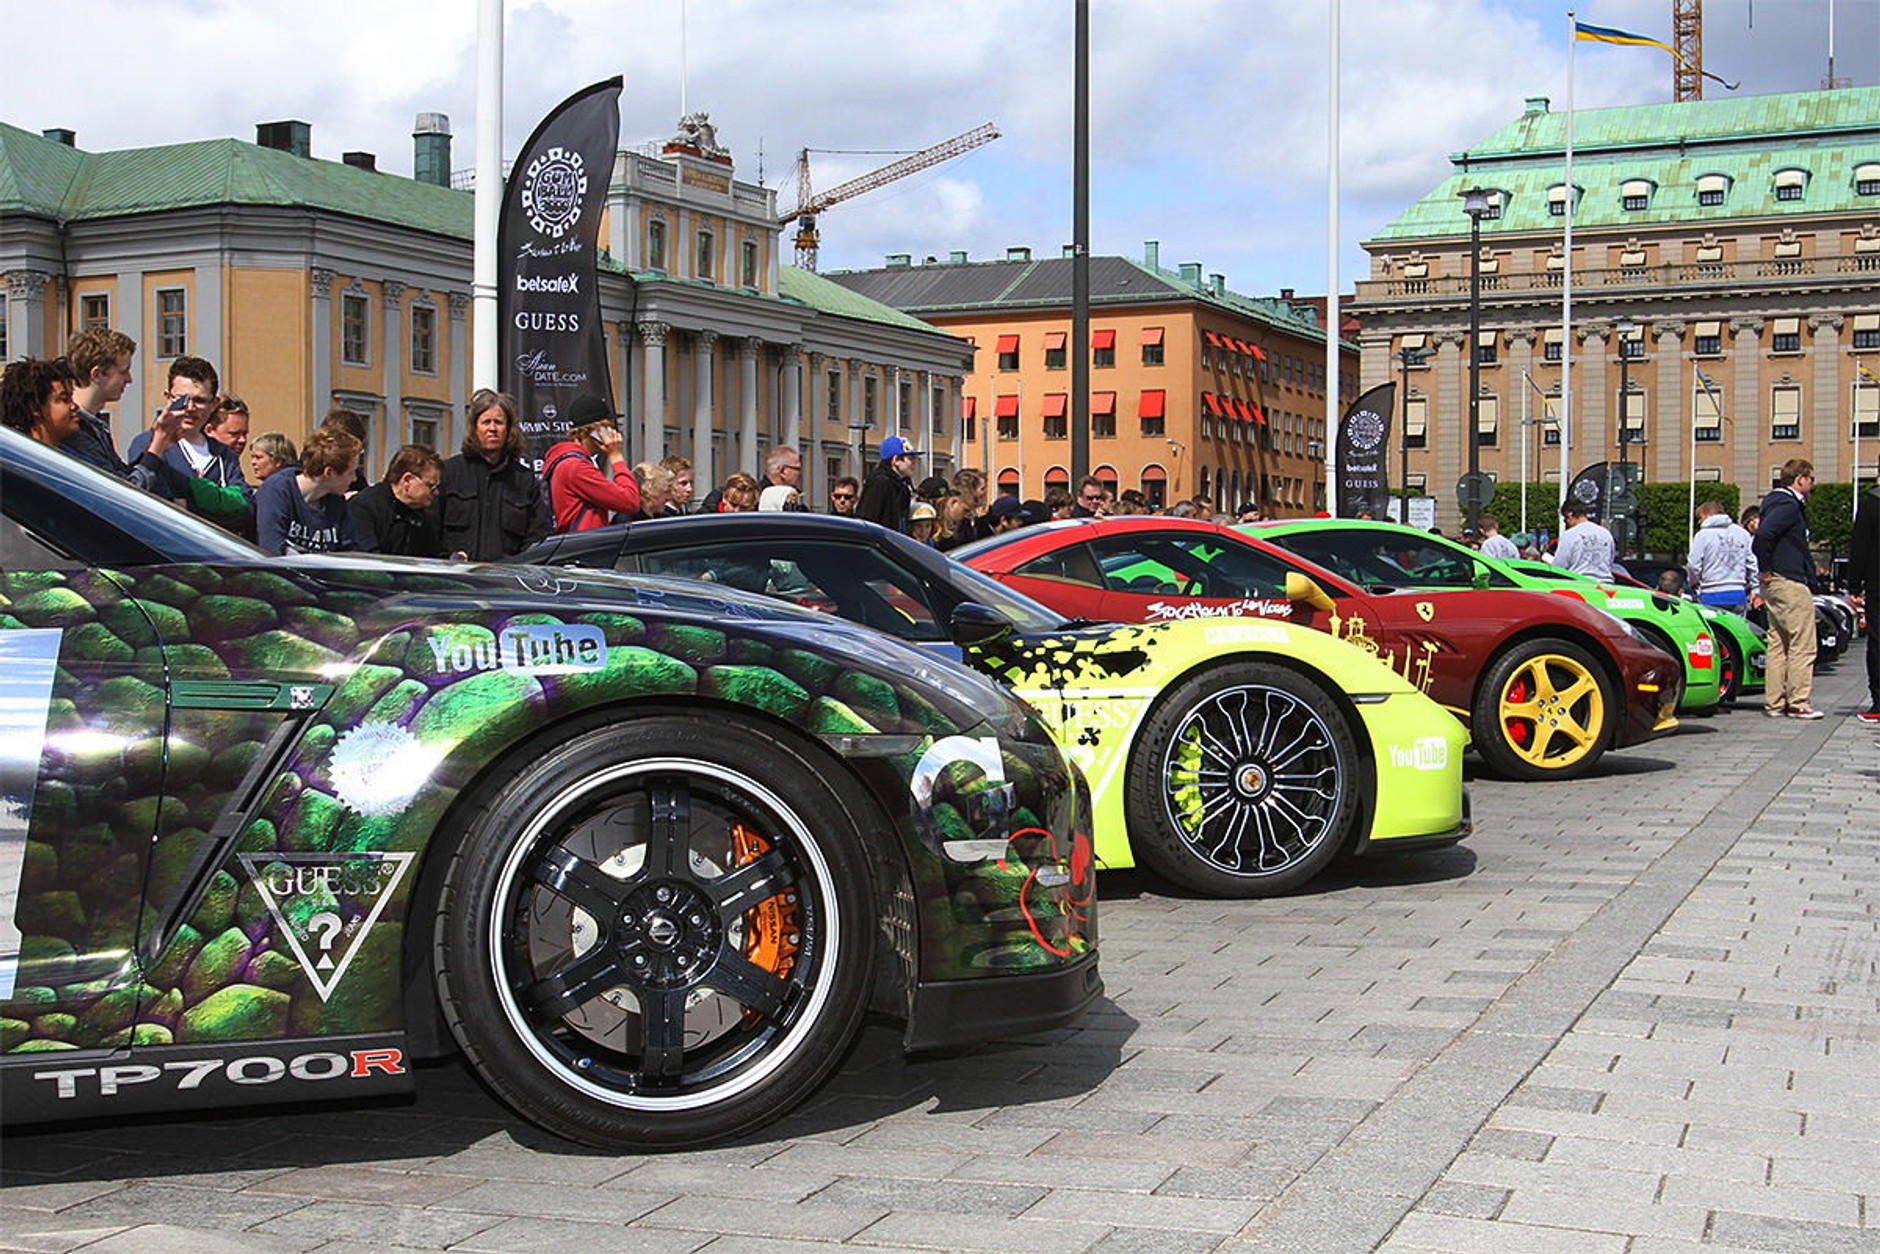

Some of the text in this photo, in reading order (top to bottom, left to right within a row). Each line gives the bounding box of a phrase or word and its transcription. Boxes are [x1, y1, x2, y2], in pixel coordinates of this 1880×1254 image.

[515, 311, 579, 332] GUESS
[268, 866, 382, 896] GUESS
[767, 900, 780, 945] NISSAN
[34, 1048, 406, 1099] TP700R
